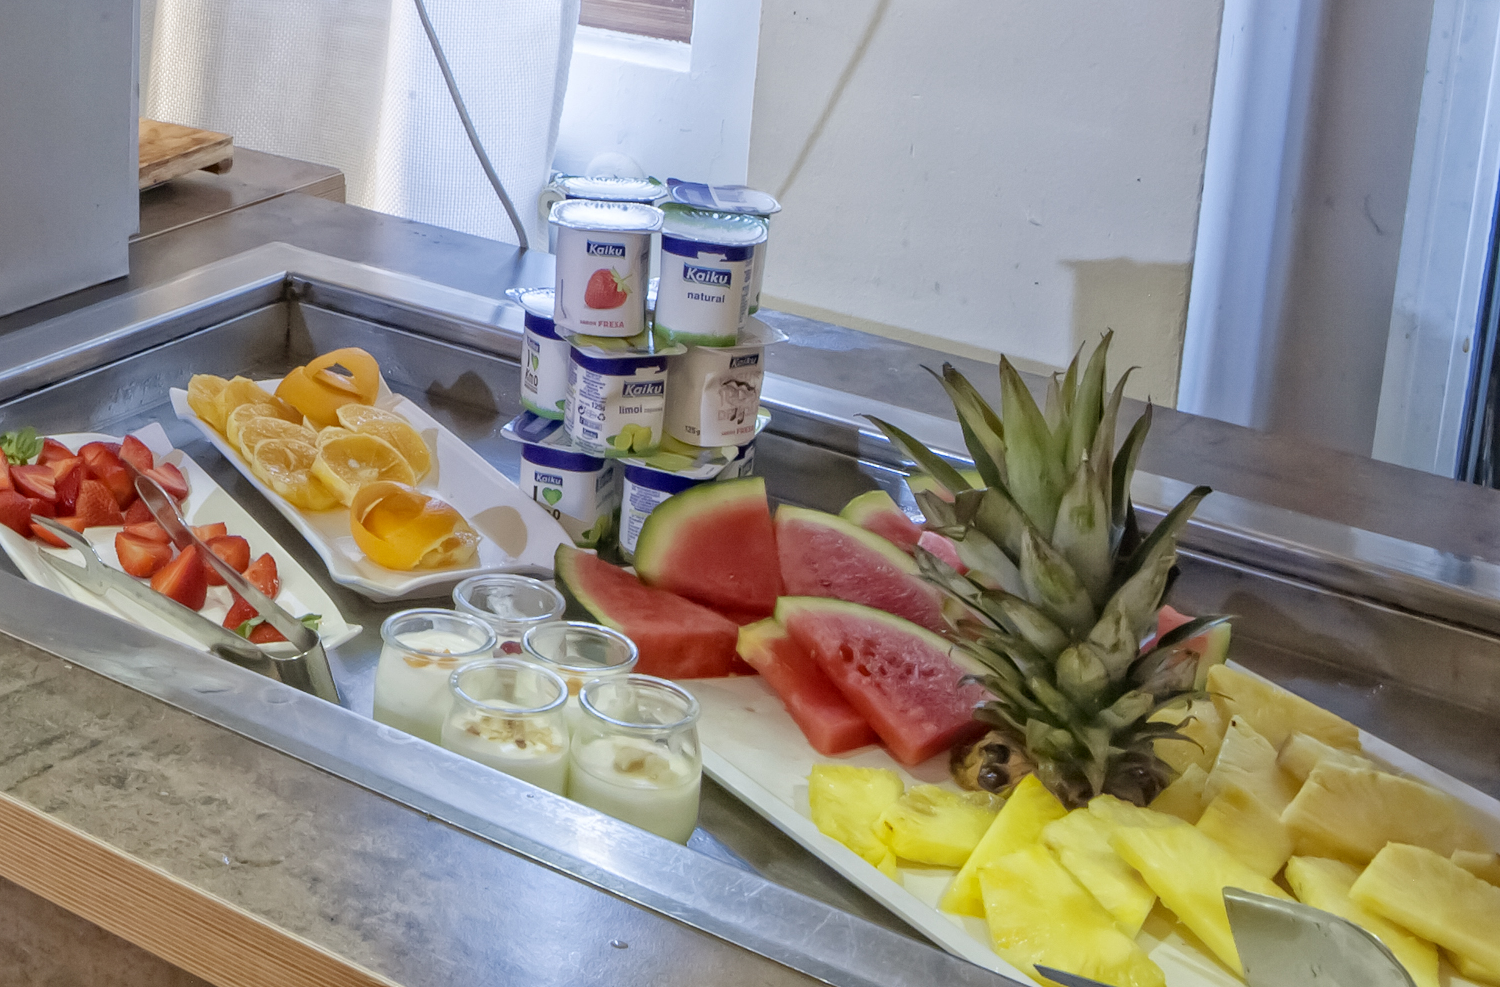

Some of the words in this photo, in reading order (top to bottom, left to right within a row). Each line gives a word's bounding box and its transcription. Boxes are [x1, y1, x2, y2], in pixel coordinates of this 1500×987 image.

[589, 243, 623, 257] Kaiku
[686, 267, 728, 285] Kaiku
[687, 291, 726, 303] natural
[598, 320, 625, 329] FRESA
[624, 382, 663, 397] Kaiku
[536, 473, 562, 485] Kaiku
